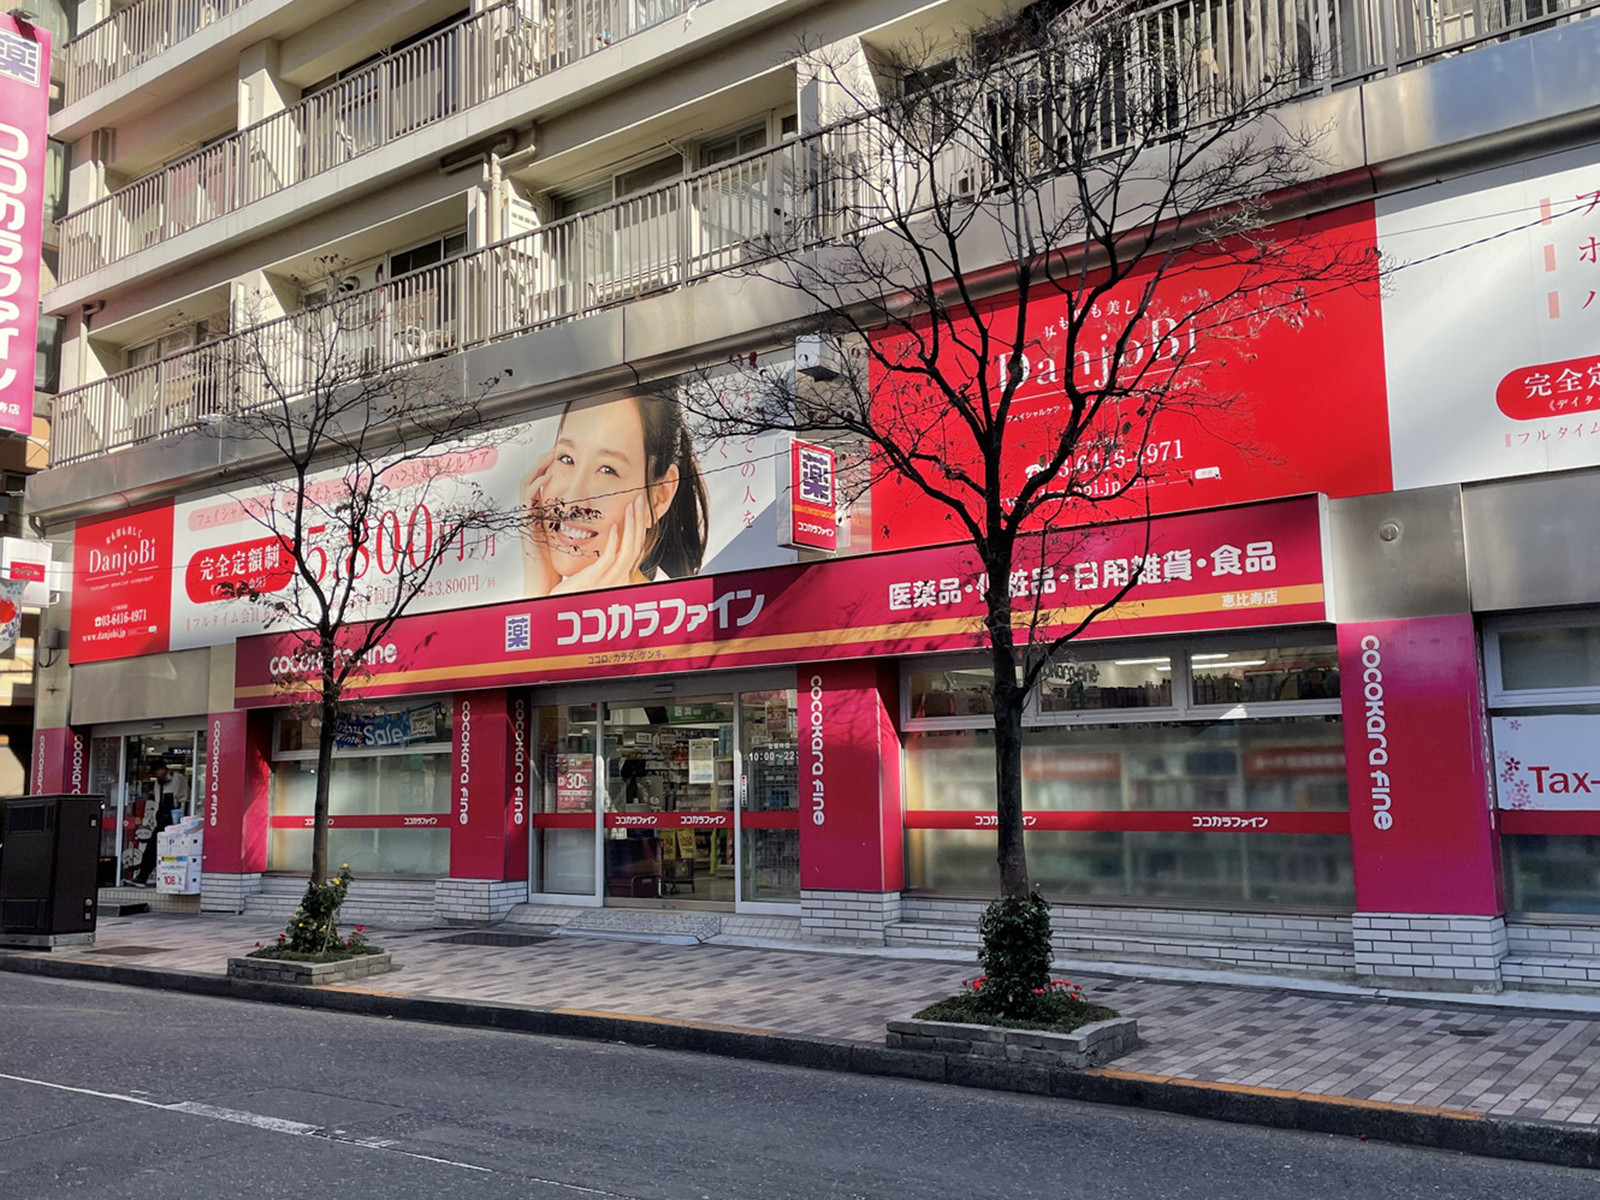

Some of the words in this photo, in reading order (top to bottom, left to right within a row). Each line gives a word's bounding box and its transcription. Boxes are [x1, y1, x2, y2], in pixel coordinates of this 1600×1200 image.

[803, 454, 829, 500] 薬
[89, 538, 156, 576] DanjoBi
[200, 543, 280, 581] 完全定額制
[557, 589, 765, 646] ココカラファイン
[1222, 590, 1278, 608] 恵比寿店
[507, 617, 529, 648] 薬
[587, 650, 667, 666] ココロ、カラダ、ゲンキ。
[1361, 634, 1388, 766] cocokara
[363, 724, 404, 746] Sale
[460, 700, 471, 784] cocokara
[515, 699, 525, 784] cocokara
[810, 675, 824, 776] cocokara
[209, 720, 221, 792] cocokara
[1528, 766, 1600, 794] Tax-
[209, 795, 219, 827] fine
[459, 786, 469, 825] fine
[514, 786, 525, 825] fine
[812, 779, 825, 826] fine
[1370, 770, 1393, 831] fine
[615, 816, 658, 825] ココカラファイン
[680, 815, 726, 825] ココカラファイン
[975, 815, 1036, 826] ココカイン
[1192, 816, 1268, 828] ココカラファイン
